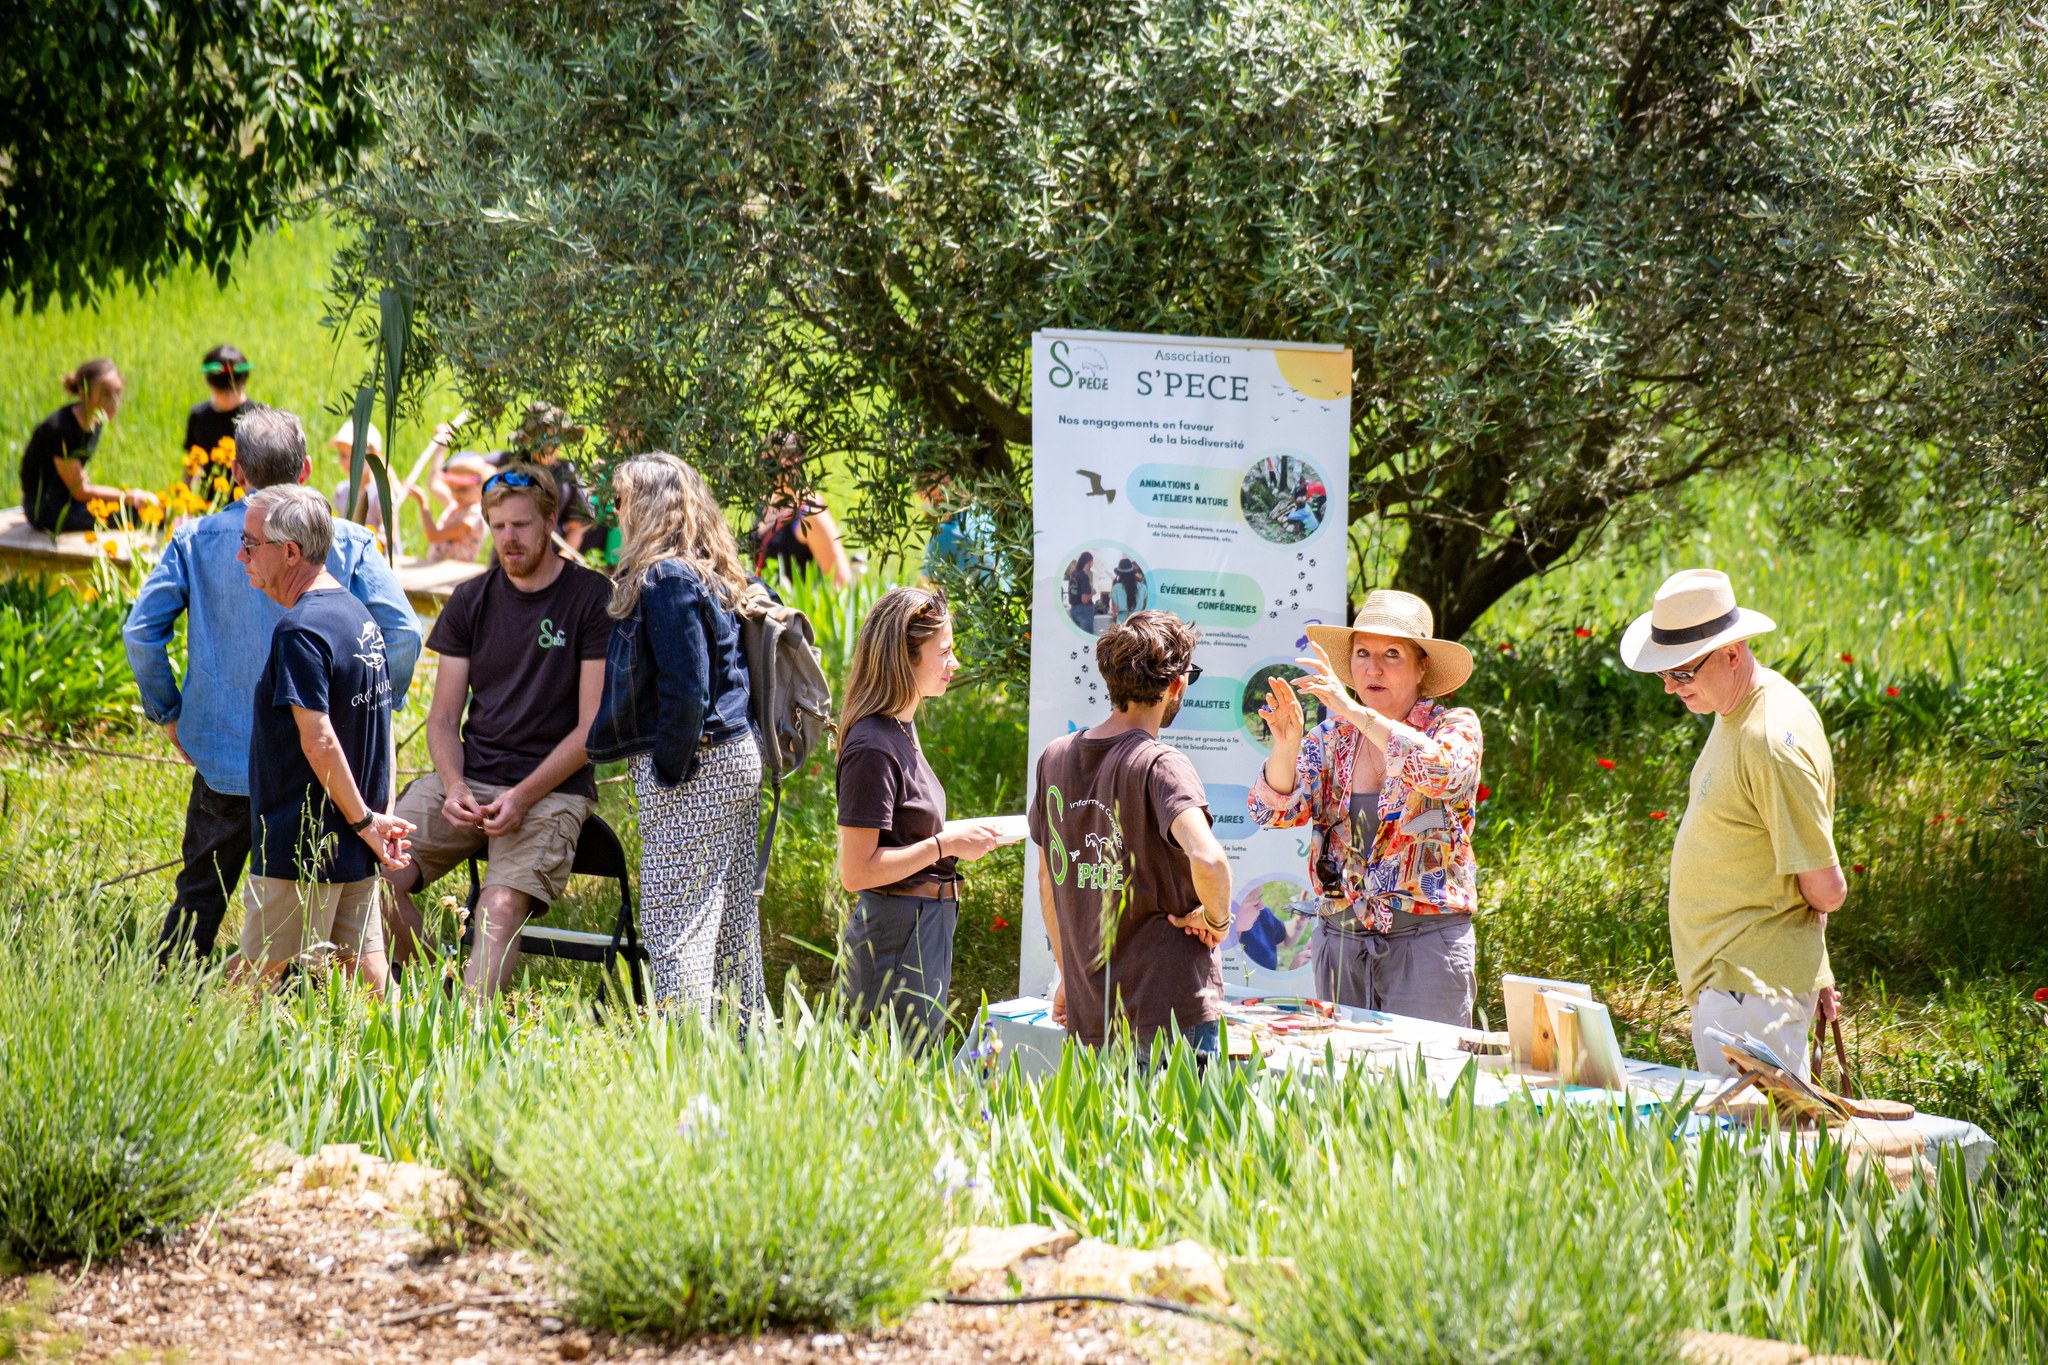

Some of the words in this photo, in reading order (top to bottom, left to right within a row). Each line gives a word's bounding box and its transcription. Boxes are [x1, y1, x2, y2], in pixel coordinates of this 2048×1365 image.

[1155, 350, 1231, 364] Association
[1137, 370, 1249, 401] S'PECE
[1058, 415, 1080, 425] Nos
[1082, 417, 1160, 430] engagements
[1162, 422, 1176, 430] en
[1179, 420, 1214, 432] faveur
[1149, 434, 1163, 444] de
[1166, 434, 1177, 445] la
[1180, 435, 1245, 450] biodiversité
[1139, 479, 1191, 490] ANIMATIONS
[1194, 482, 1200, 491] &
[1152, 493, 1193, 504] ATELIERS
[1195, 496, 1229, 507] NATURE
[1160, 583, 1217, 597] ÉVÉNEMENTS
[1219, 589, 1226, 598] &
[1197, 600, 1257, 614] CONFÉRENCES
[1190, 743, 1228, 752] biodiversité
